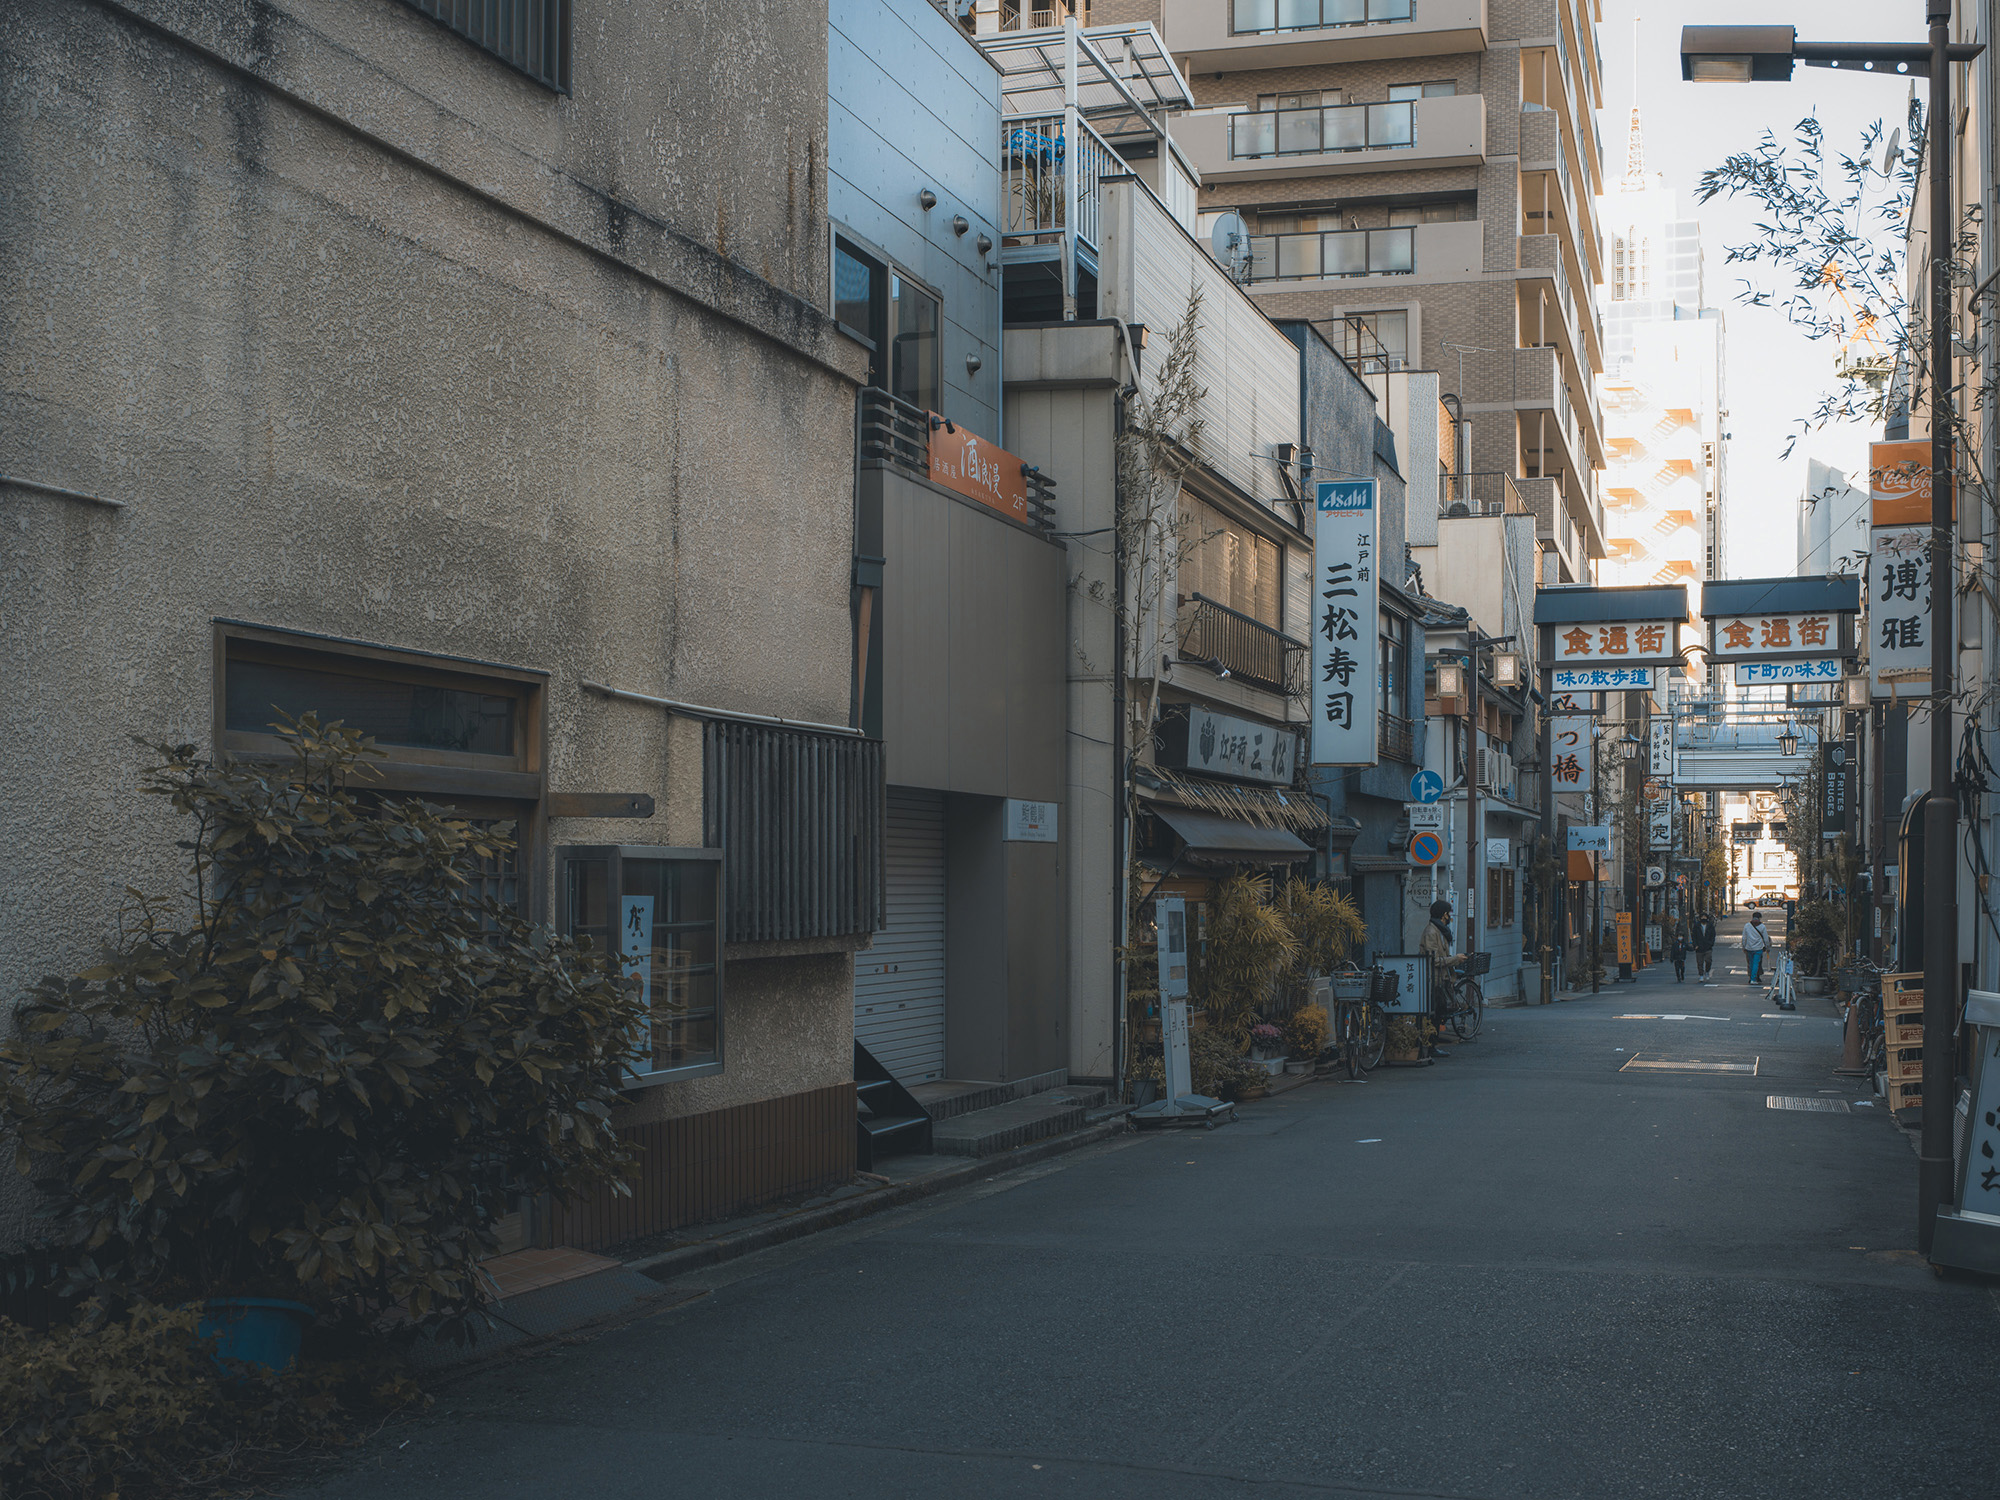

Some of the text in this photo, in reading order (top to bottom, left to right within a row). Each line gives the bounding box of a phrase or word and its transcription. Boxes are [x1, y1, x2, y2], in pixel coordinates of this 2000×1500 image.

[933, 456, 958, 480] 居酒屋
[1012, 493, 1025, 512] 2F
[1322, 488, 1367, 508] Asahi
[1325, 510, 1365, 518] アサヒビール
[1357, 533, 1371, 582] 江戸前
[1879, 557, 1925, 651] 博雅
[1562, 624, 1667, 656] 食通街
[1722, 616, 1830, 649] 食通街
[1319, 561, 1359, 731] 三松寿司
[1556, 668, 1650, 688] 味の散歩道
[1740, 660, 1838, 681] 下町の味処
[1827, 772, 1836, 817] BRUGES
[1837, 772, 1846, 812] FRITES
[1411, 813, 1442, 821] 一方通行
[1899, 993, 1924, 1001] アサヒビー
